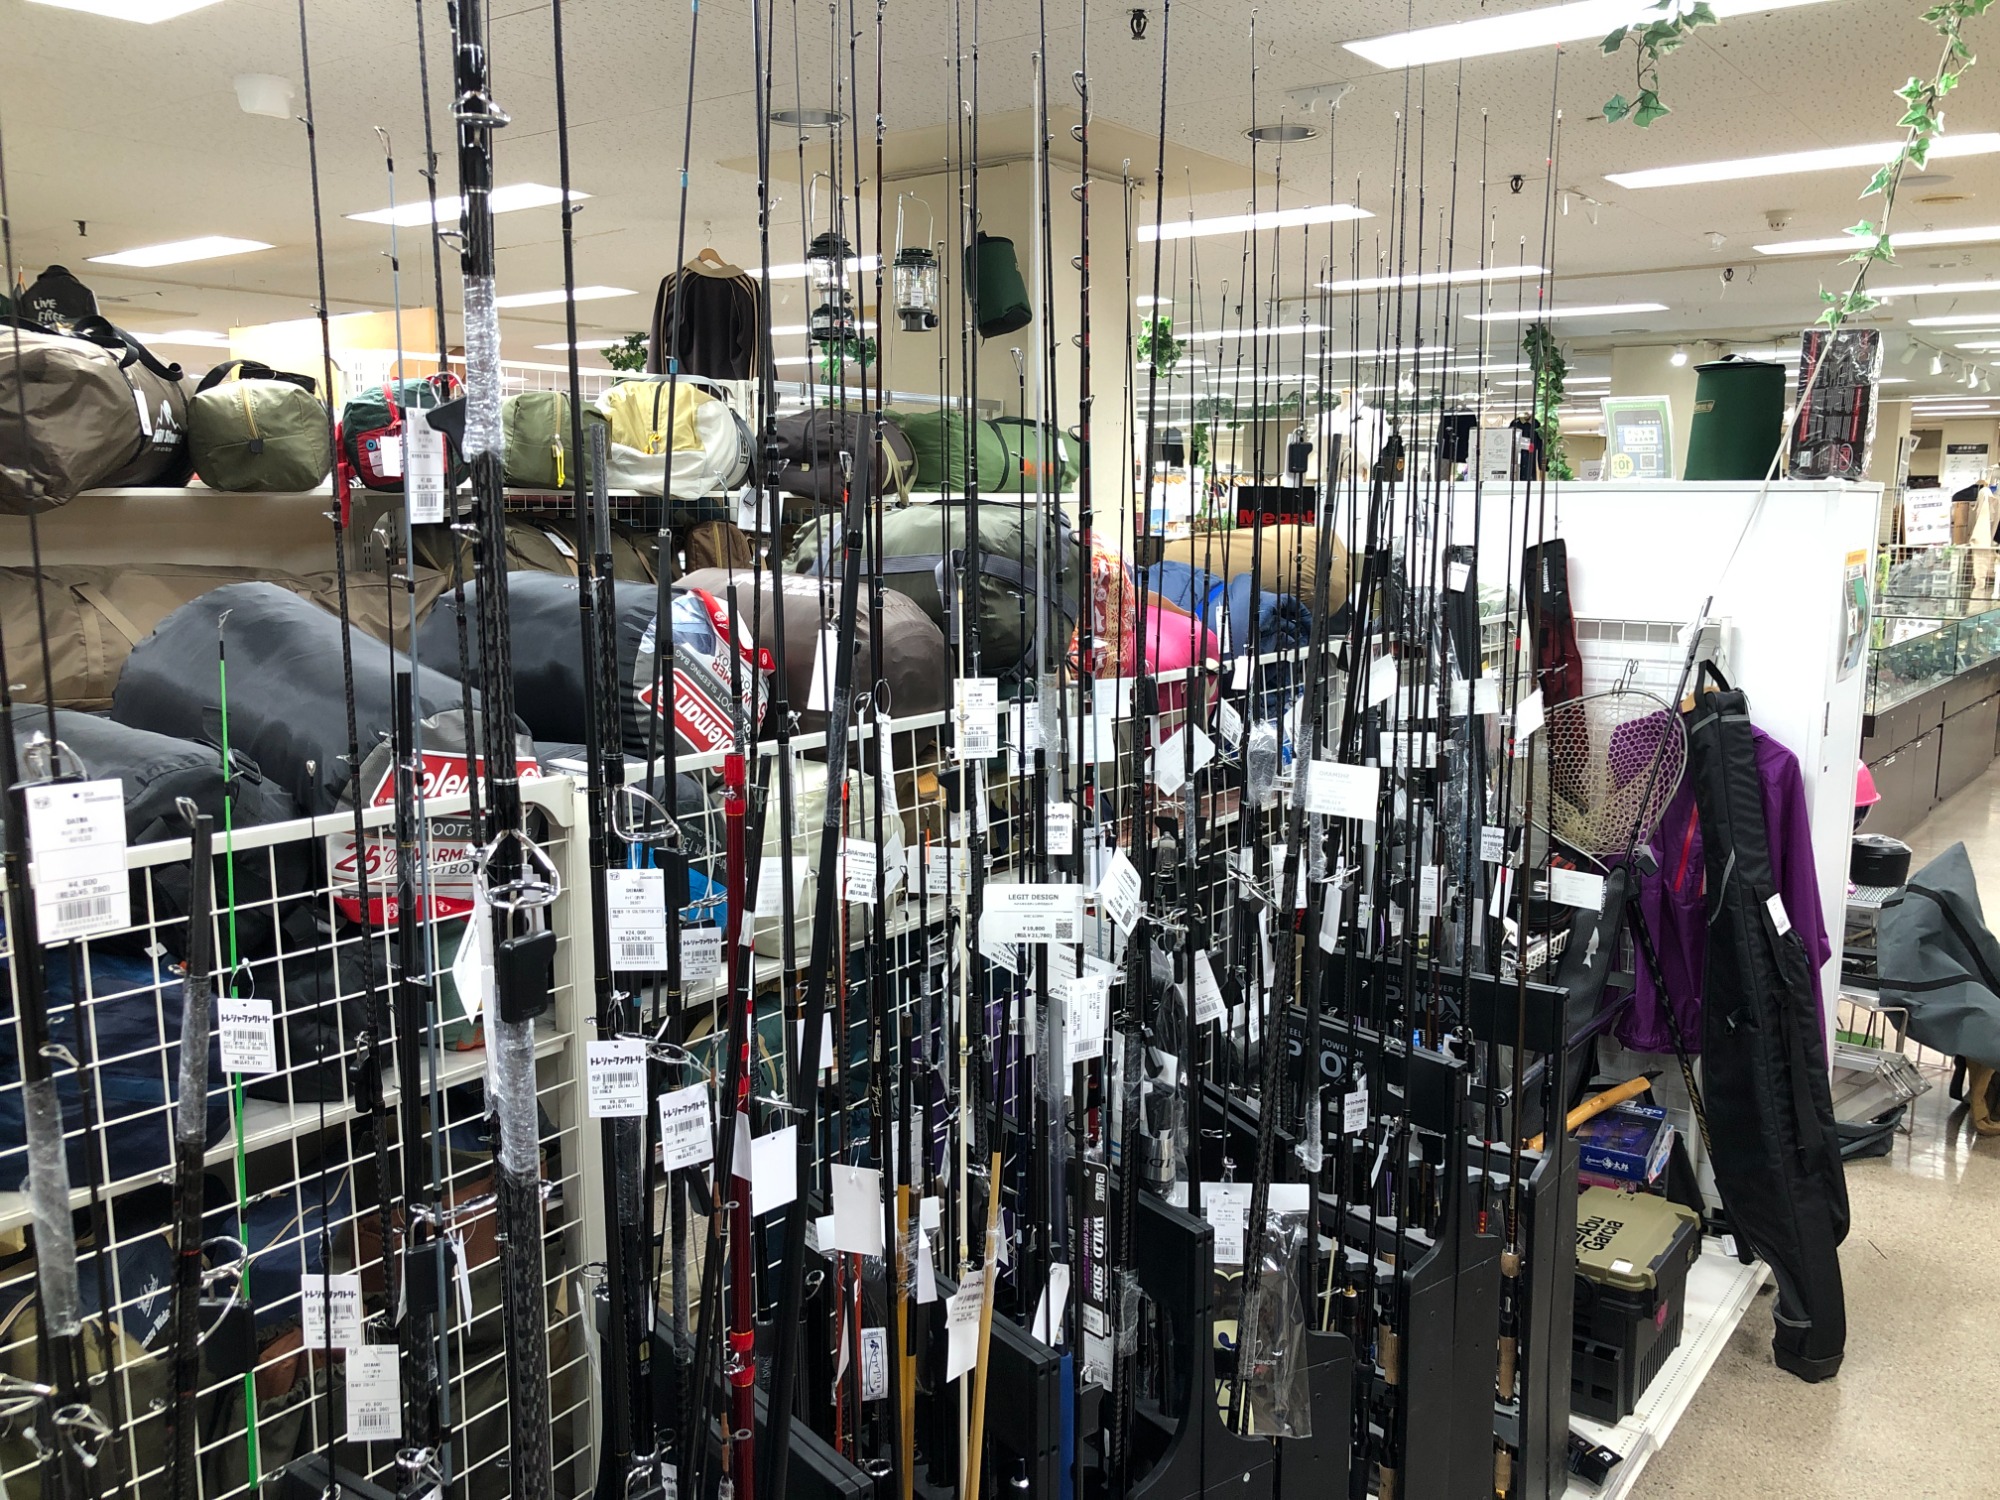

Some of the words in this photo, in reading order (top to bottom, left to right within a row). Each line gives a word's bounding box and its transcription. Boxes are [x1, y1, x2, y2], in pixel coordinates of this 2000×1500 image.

[675, 649, 691, 666] BAG
[221, 1014, 270, 1023] トレジャーファクトリー
[590, 1055, 645, 1066] トレジャーファクトリー
[663, 1100, 708, 1119] トレジャーファクトリー
[1577, 1216, 1606, 1237] Abu
[1582, 1220, 1624, 1251] Garcia
[1092, 1215, 1105, 1259] WILD
[1092, 1263, 1105, 1303] SIDE
